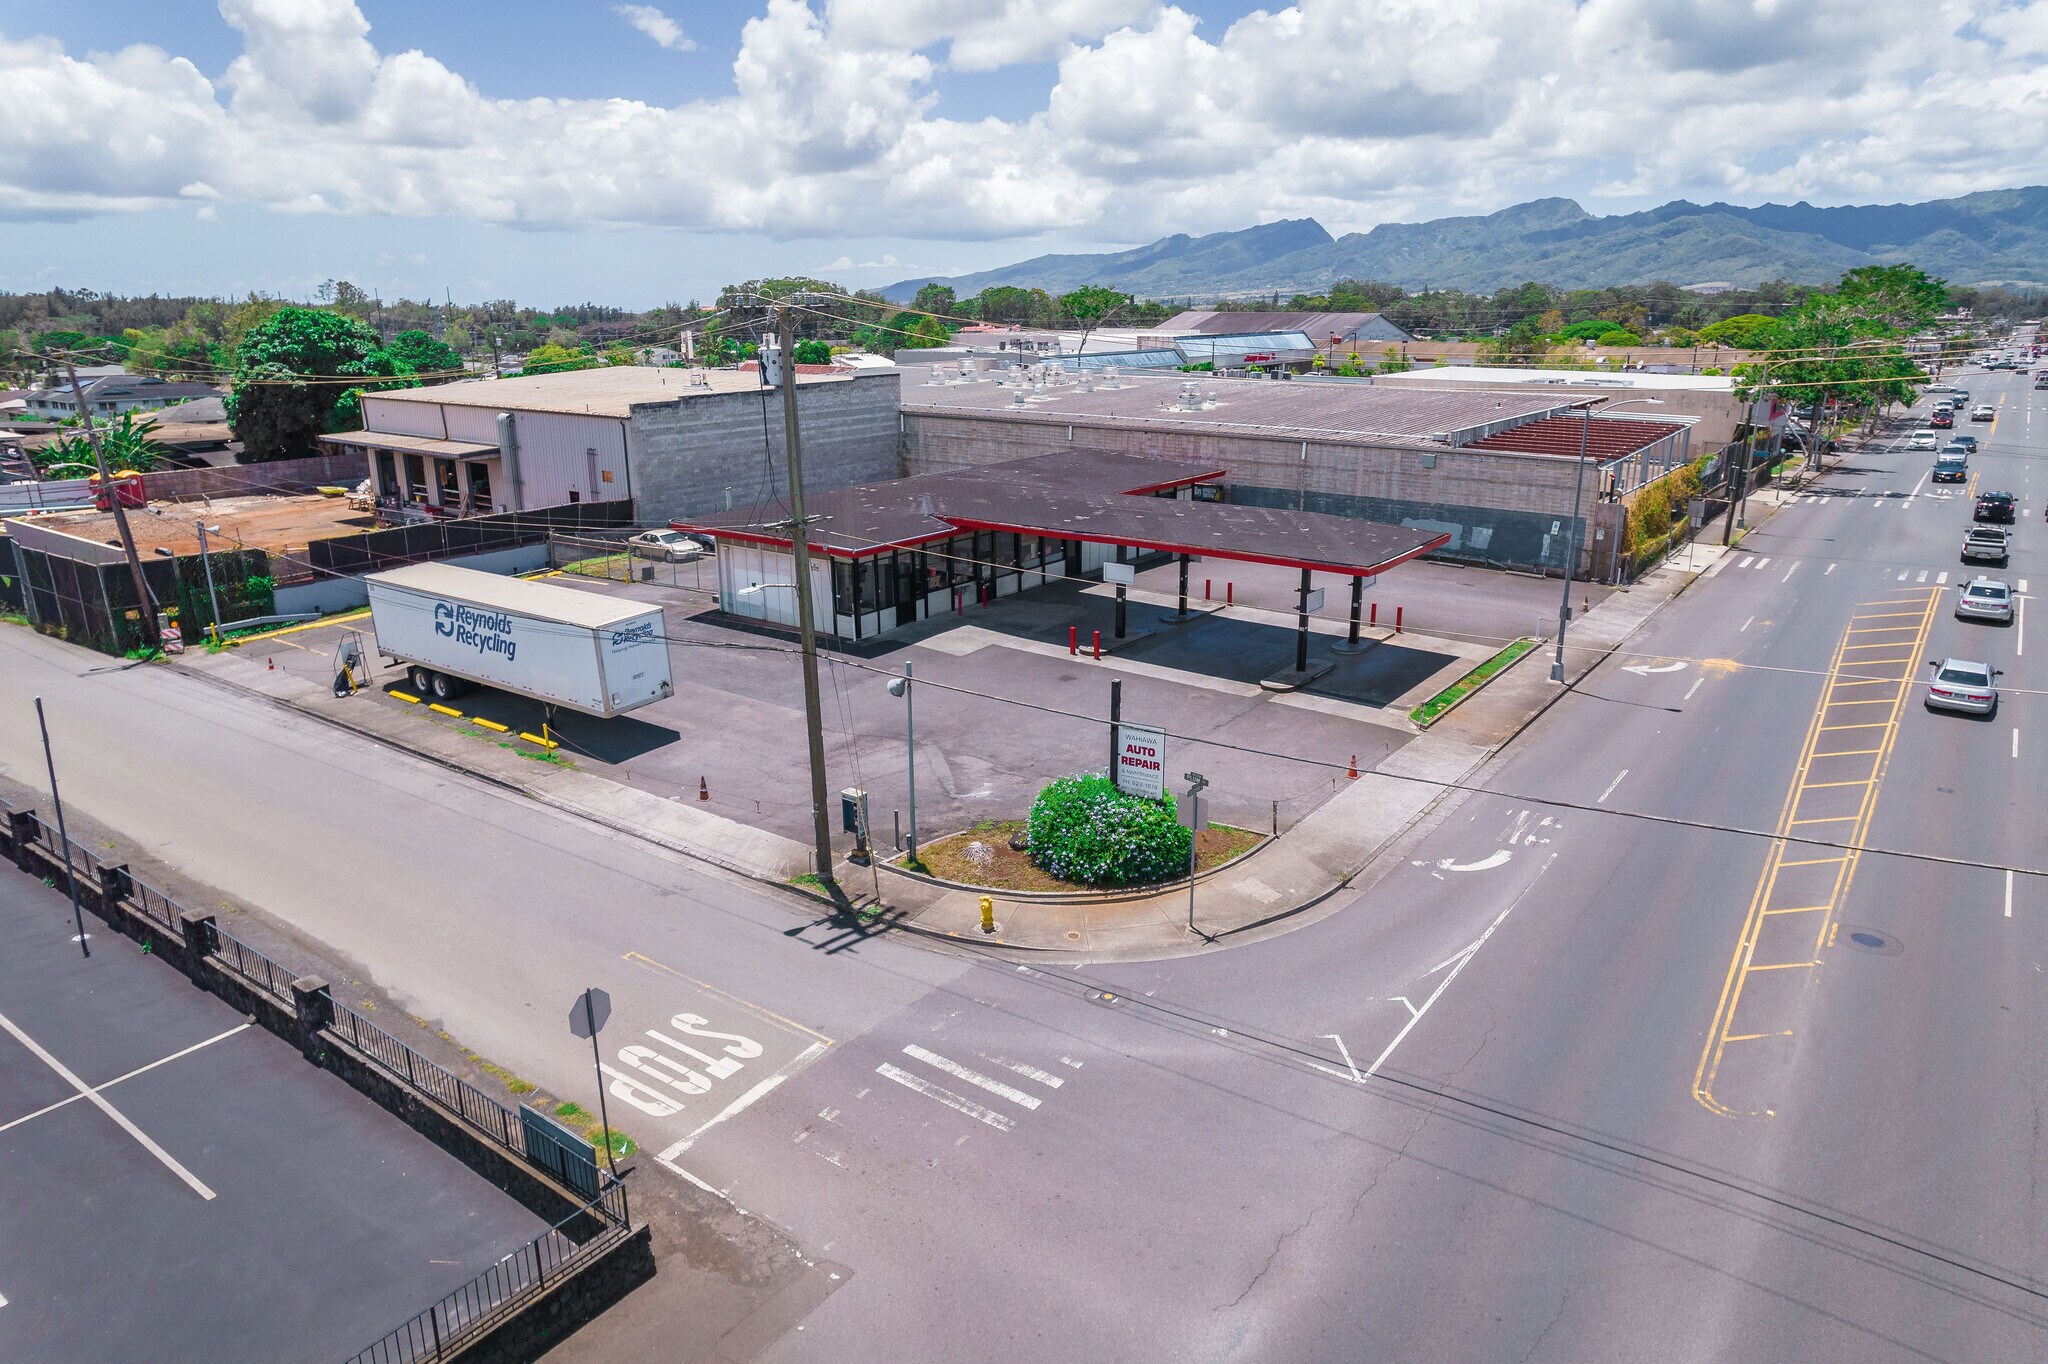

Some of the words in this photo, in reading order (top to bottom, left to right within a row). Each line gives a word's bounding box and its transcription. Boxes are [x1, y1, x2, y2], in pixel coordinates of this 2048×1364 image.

[456, 604, 512, 635] Reynolds
[624, 621, 652, 636] Reynolds
[456, 624, 516, 661] Recycling
[624, 629, 653, 644] Recying
[1125, 734, 1157, 745] WAHIAWA
[1126, 744, 1156, 757] AUTO
[1121, 755, 1160, 771] REPAIR
[1126, 769, 1159, 780] MAINTENANCE
[593, 1012, 763, 1117] STOP
